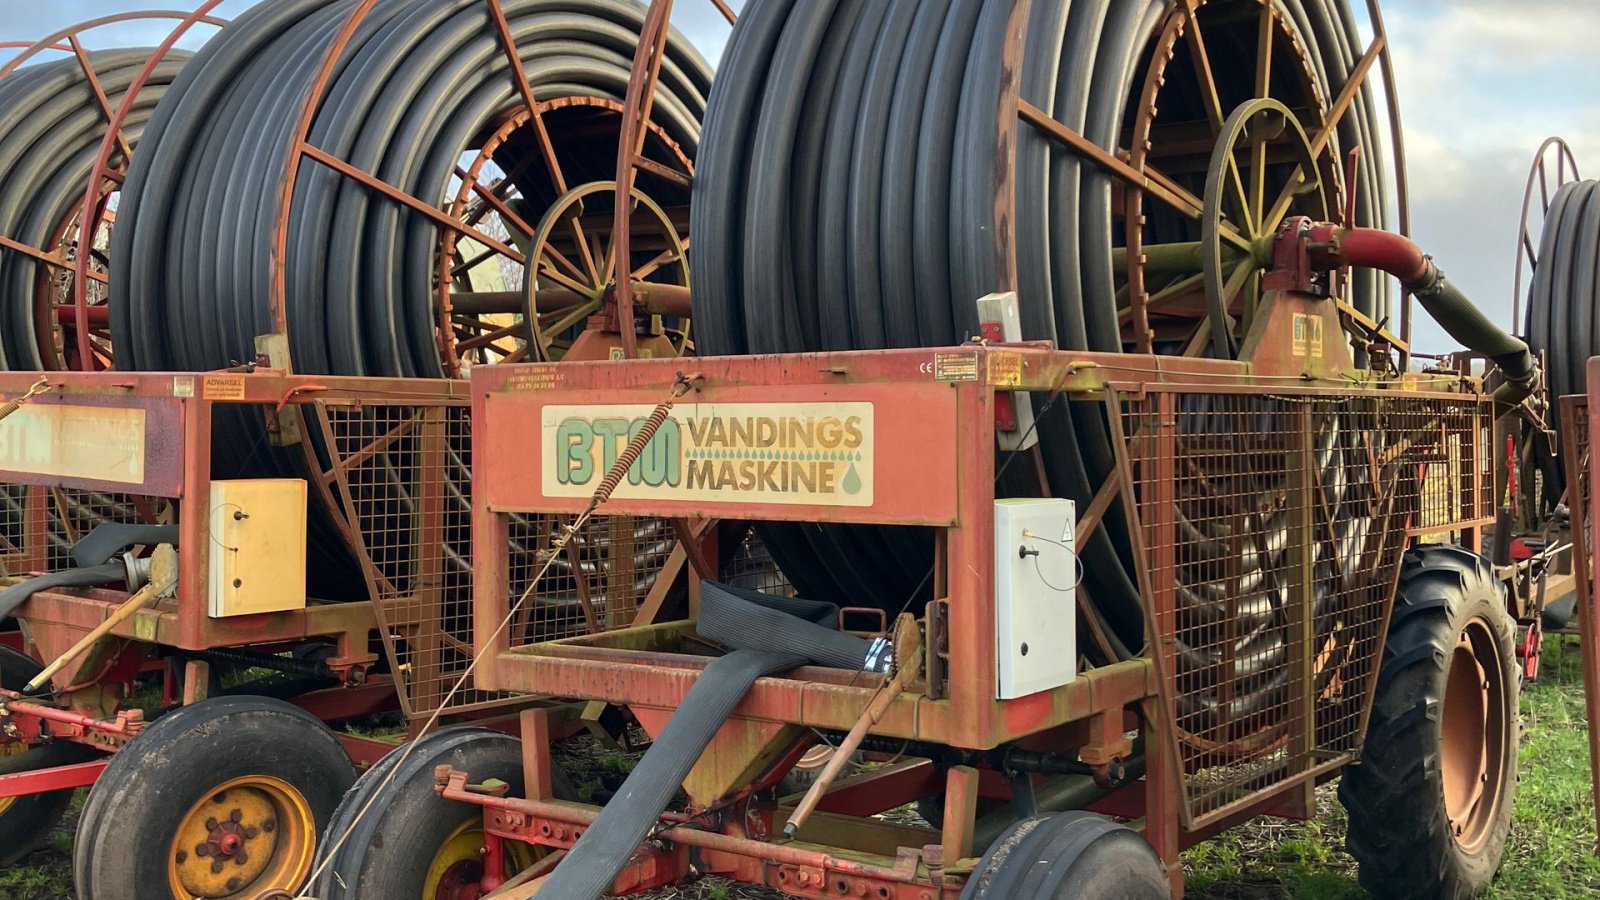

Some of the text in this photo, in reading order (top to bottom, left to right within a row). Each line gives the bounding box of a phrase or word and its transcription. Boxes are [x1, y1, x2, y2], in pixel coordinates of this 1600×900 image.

[919, 362, 932, 374] CE
[686, 415, 863, 450] VANDINGS
[556, 415, 682, 488] BTM
[686, 458, 836, 494] MASKINE
